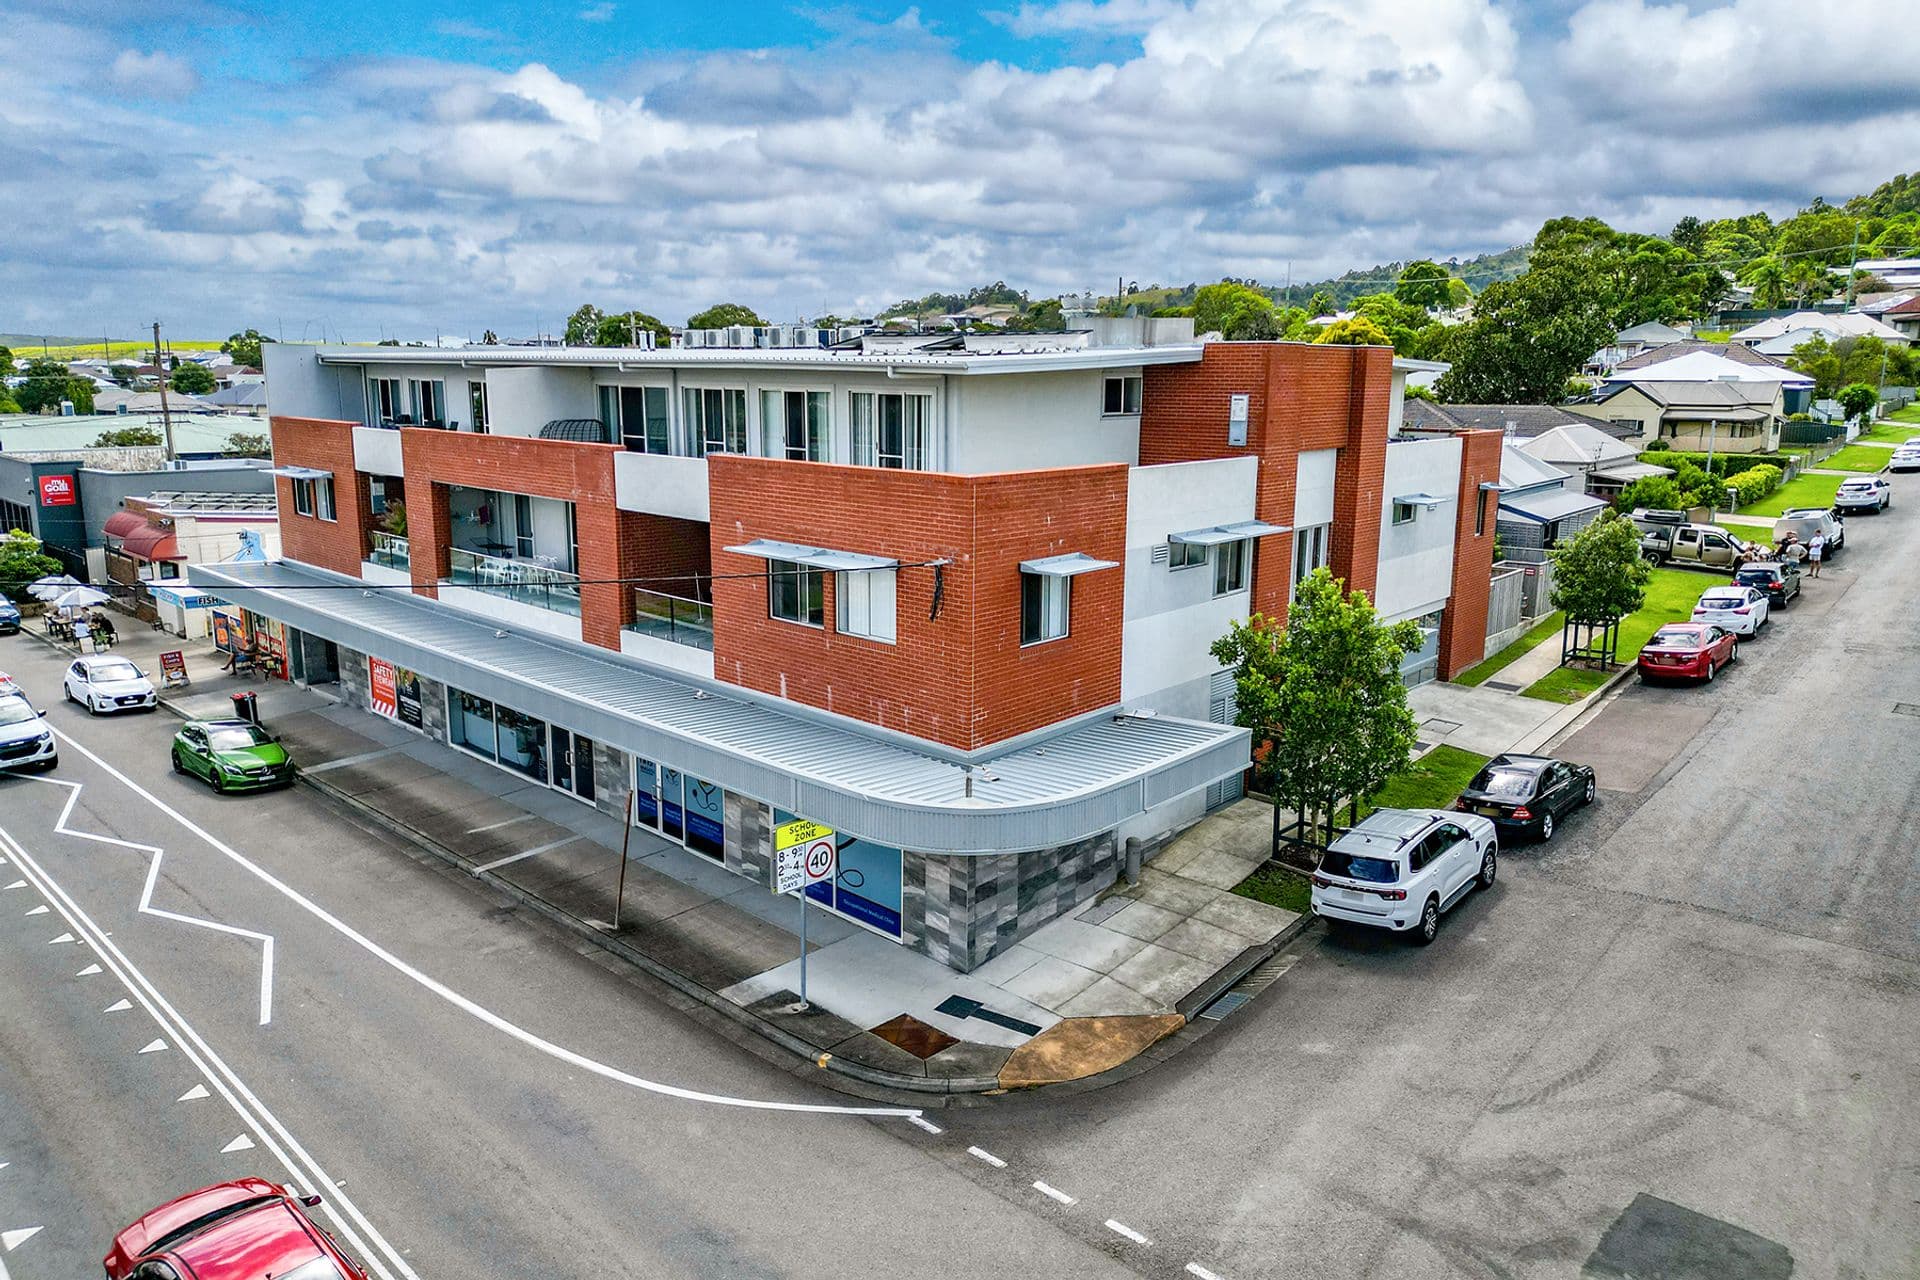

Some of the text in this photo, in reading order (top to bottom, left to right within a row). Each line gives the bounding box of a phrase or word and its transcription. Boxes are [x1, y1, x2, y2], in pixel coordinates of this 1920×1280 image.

[198, 597, 219, 605] FISH
[373, 663, 394, 680] SAFETY
[789, 821, 820, 834] SCHOO
[795, 828, 816, 841] ZONE
[811, 851, 828, 868] 40
[780, 872, 802, 884] SCHOOL
[783, 881, 798, 890] DAYS
